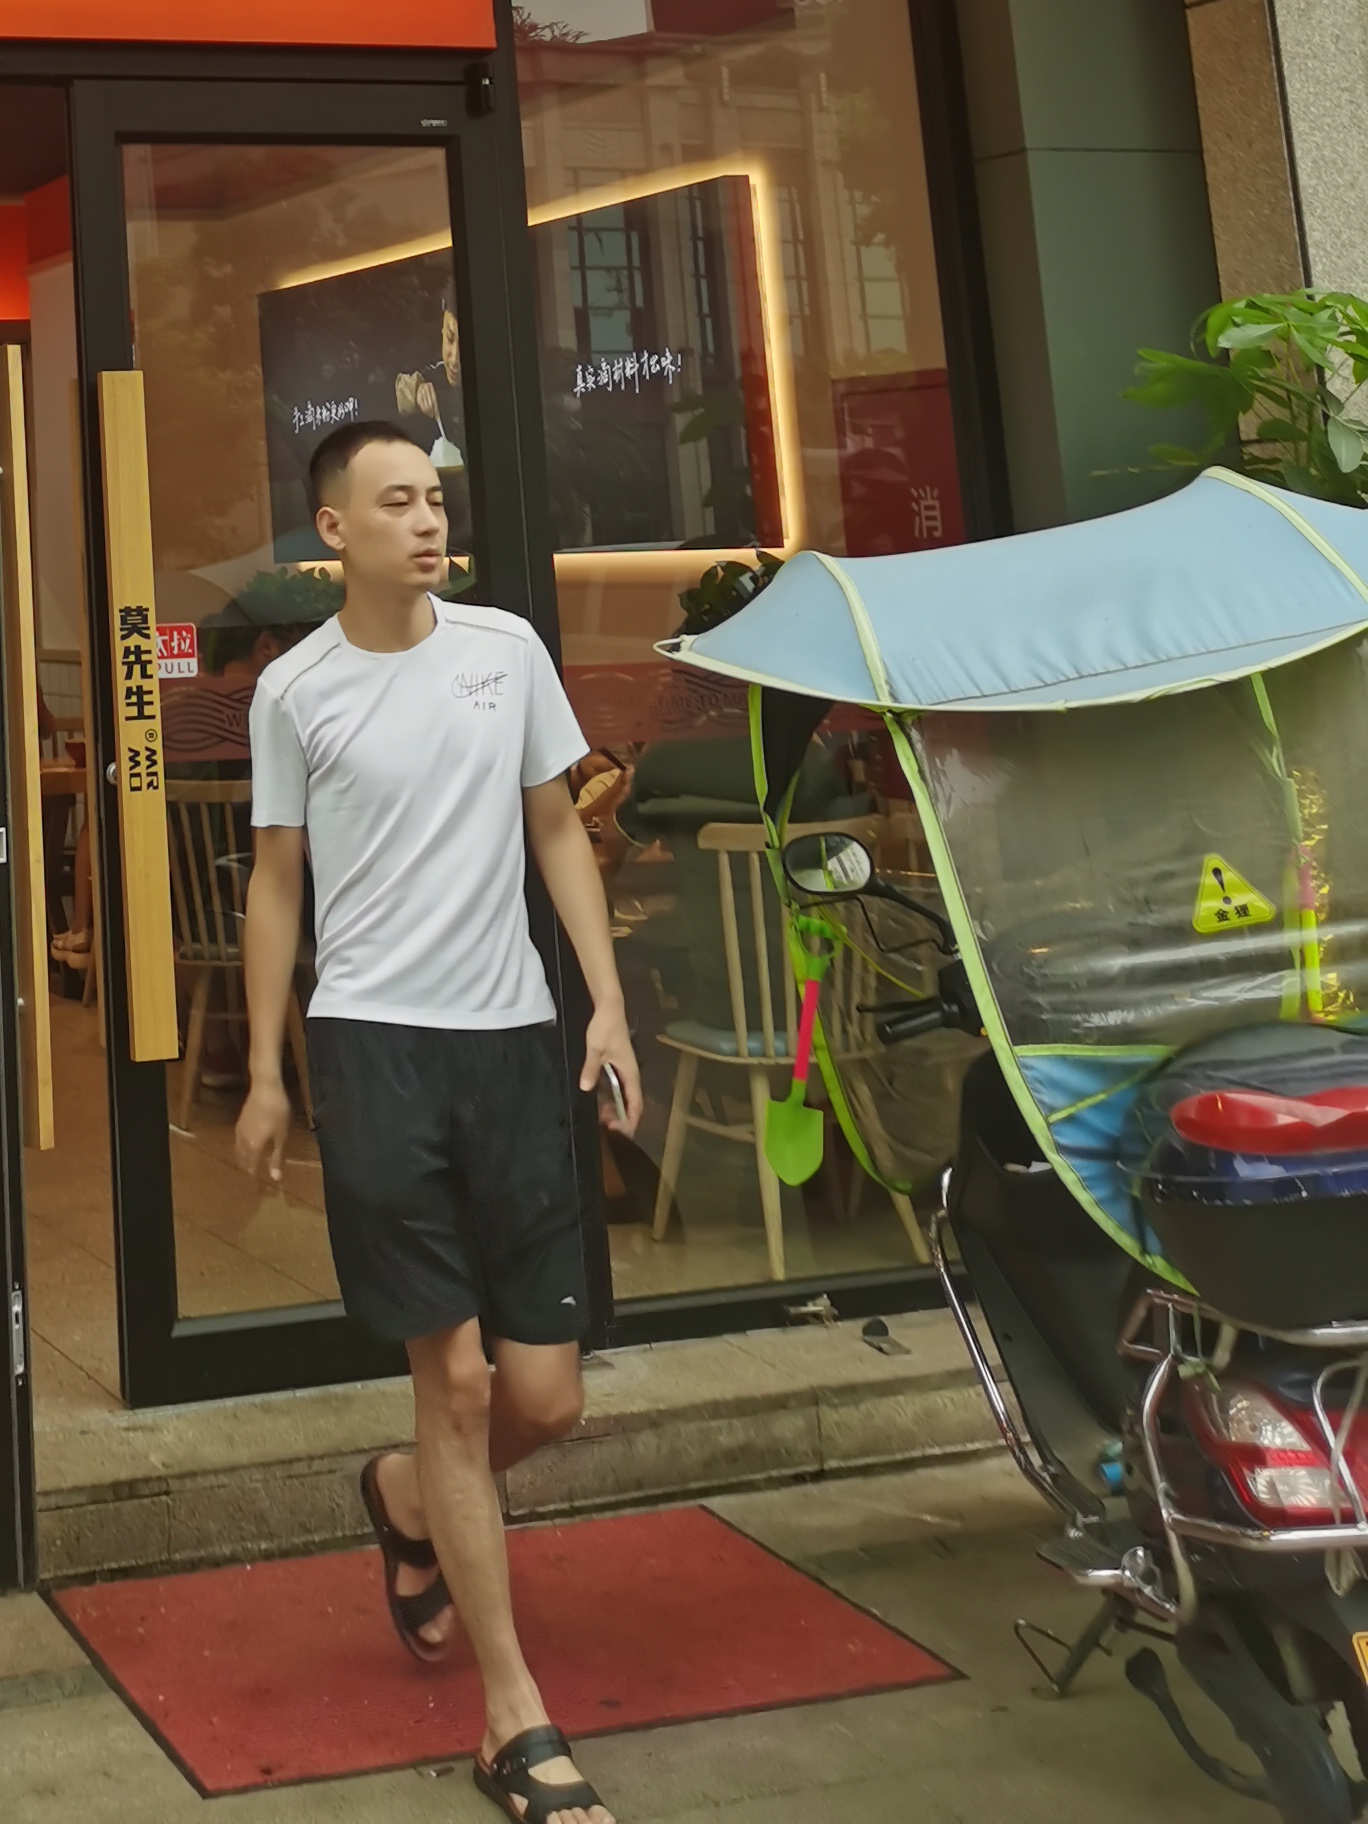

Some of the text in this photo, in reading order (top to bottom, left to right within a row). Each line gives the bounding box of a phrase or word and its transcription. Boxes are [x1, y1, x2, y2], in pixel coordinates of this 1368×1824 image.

[118, 606, 157, 722] 莫先生
[473, 701, 497, 712] AIR
